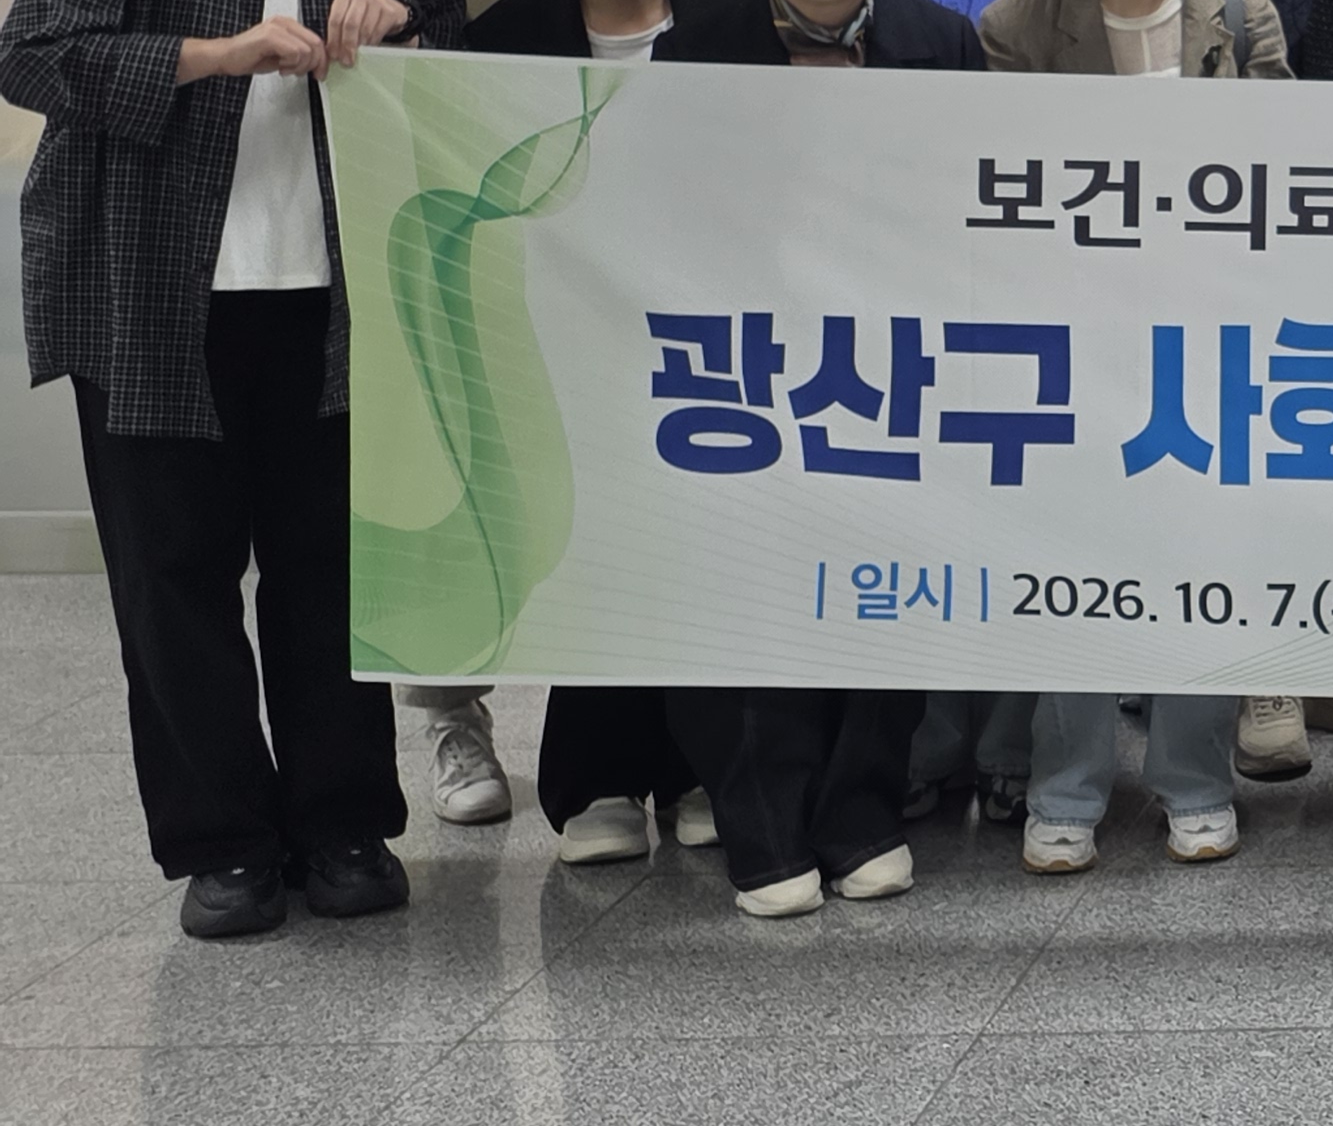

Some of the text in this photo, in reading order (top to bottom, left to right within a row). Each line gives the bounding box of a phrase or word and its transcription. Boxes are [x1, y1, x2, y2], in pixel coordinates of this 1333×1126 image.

[645, 311, 1076, 488] 광산구
[849, 562, 955, 623] 일시
[1011, 571, 1160, 623] 2026.
[1175, 580, 1250, 628] 10.
